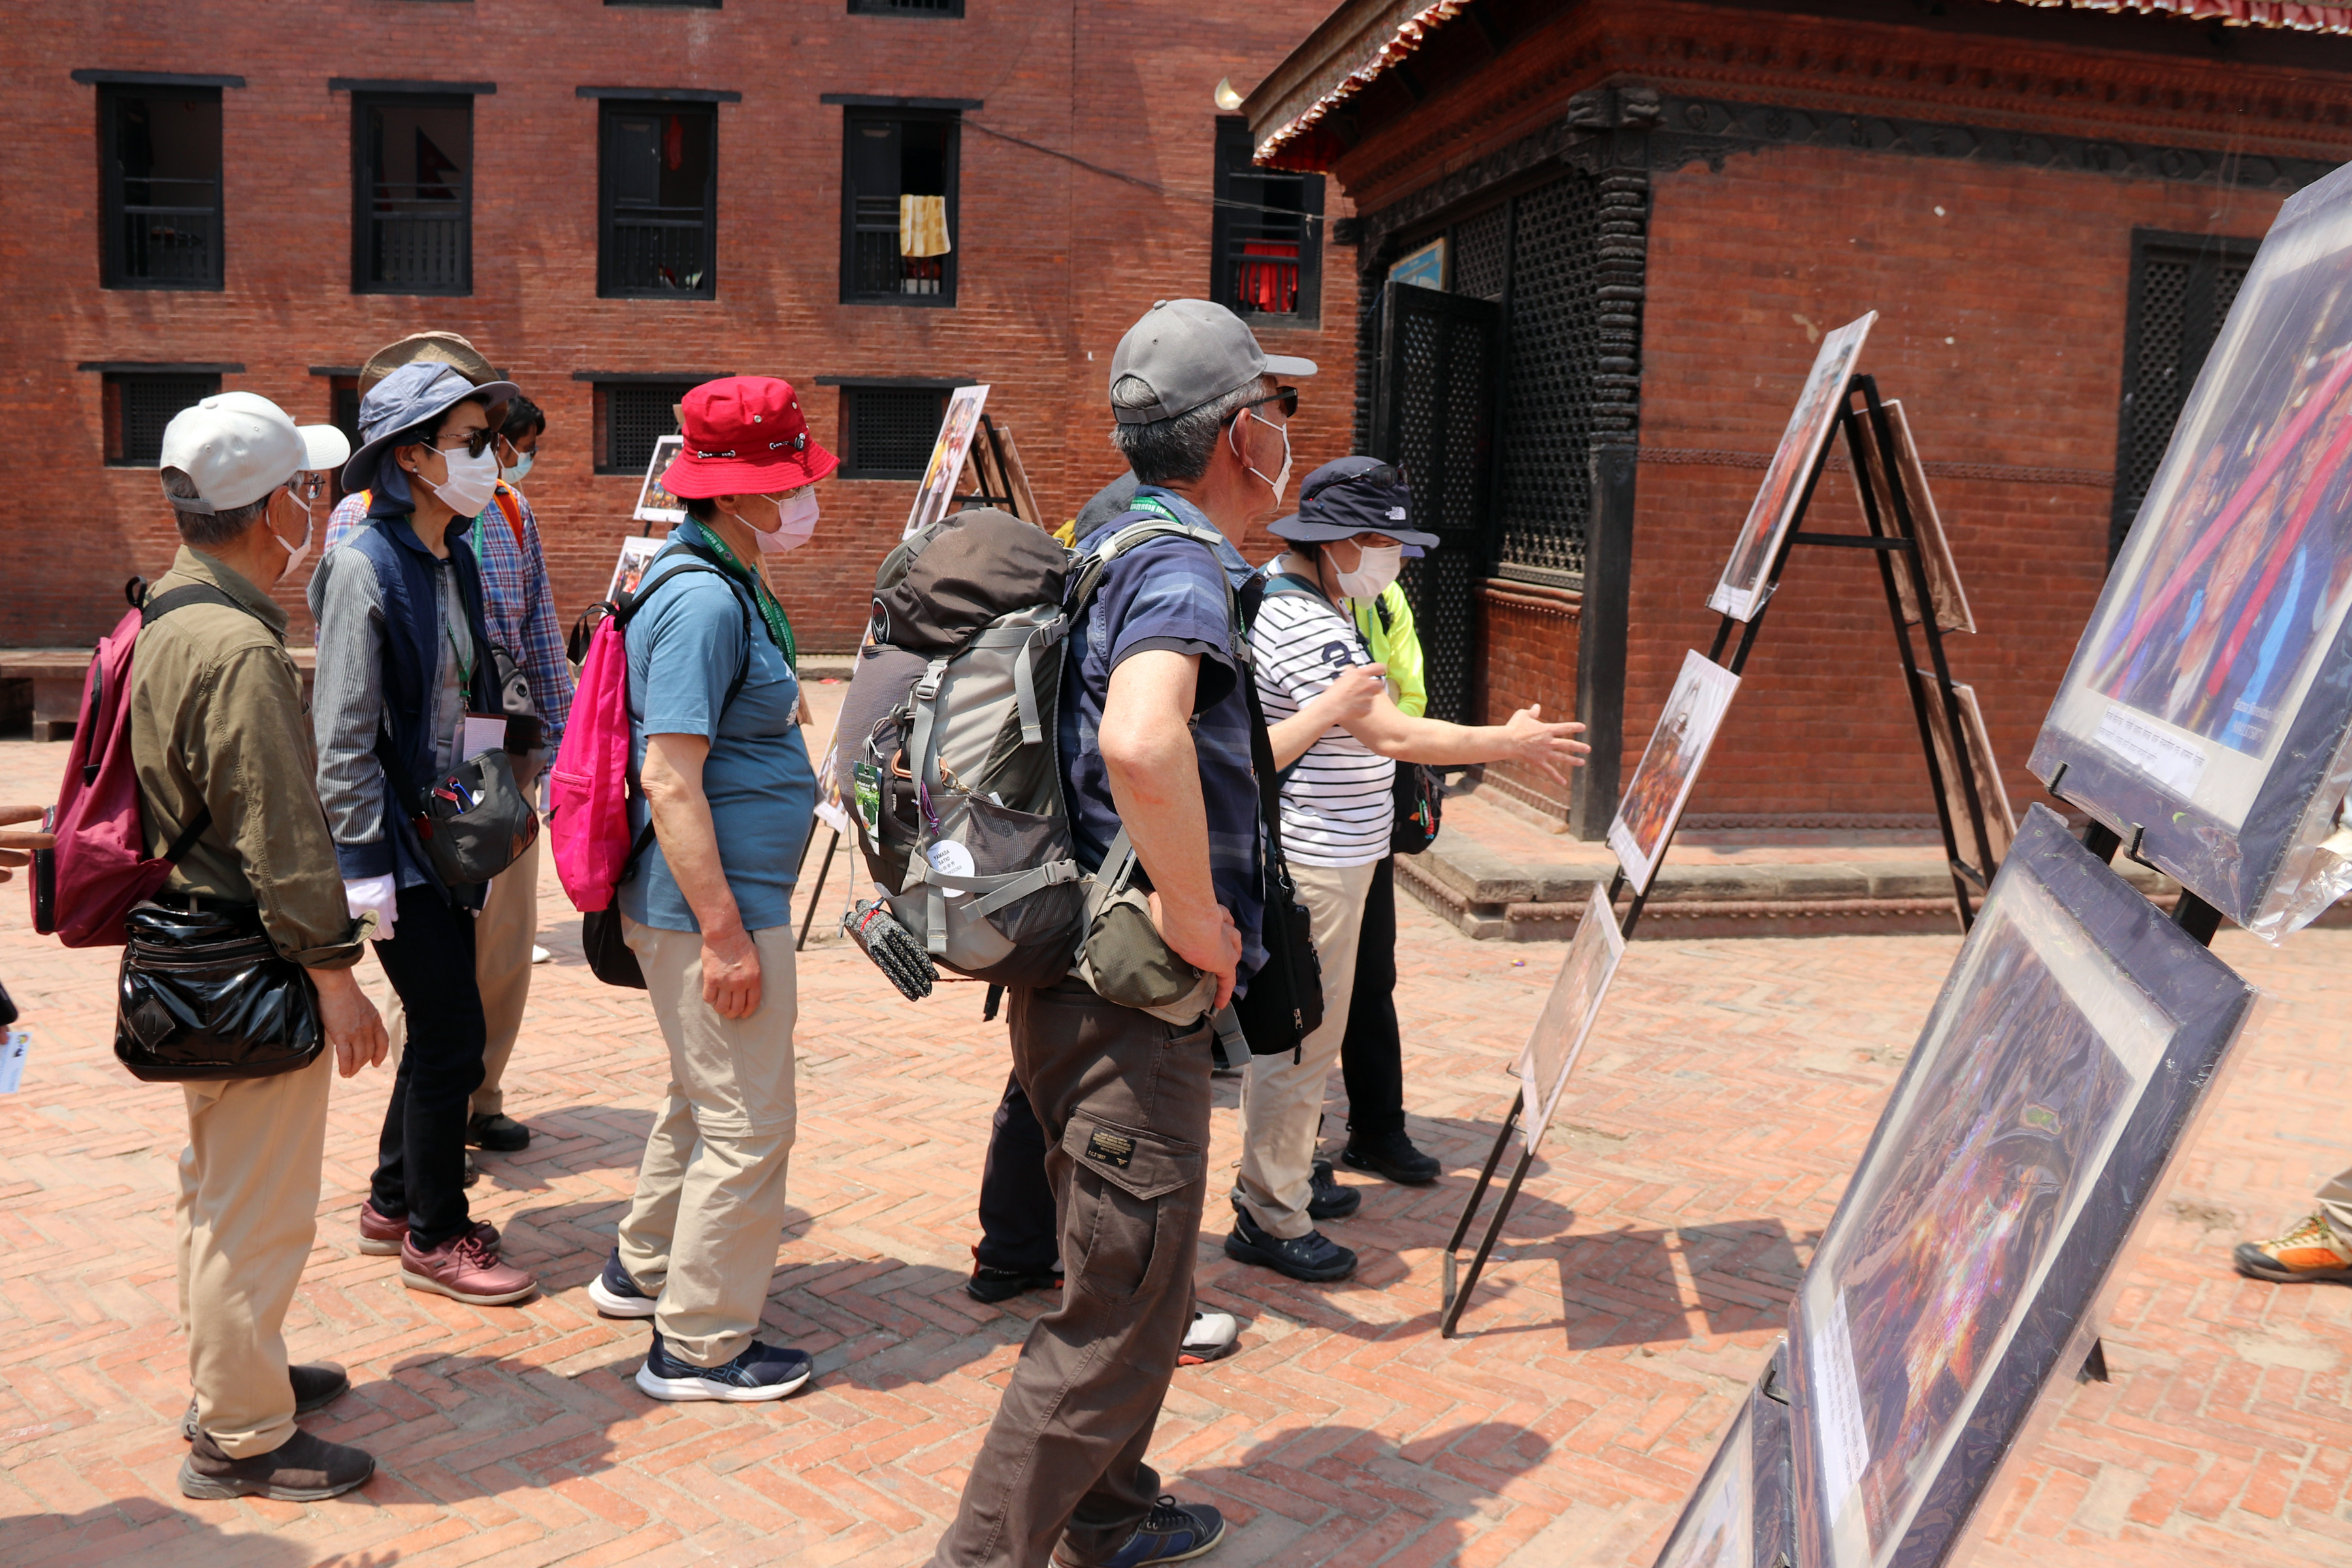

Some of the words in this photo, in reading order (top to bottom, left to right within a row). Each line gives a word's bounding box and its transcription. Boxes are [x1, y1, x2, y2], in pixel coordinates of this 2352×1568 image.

[1141, 504, 1156, 513] Nepal
[1155, 506, 1167, 514] All
[702, 531, 717, 545] Nepal
[715, 542, 725, 553] All
[934, 849, 950, 860] YAMADA
[938, 857, 951, 865] SATIO
